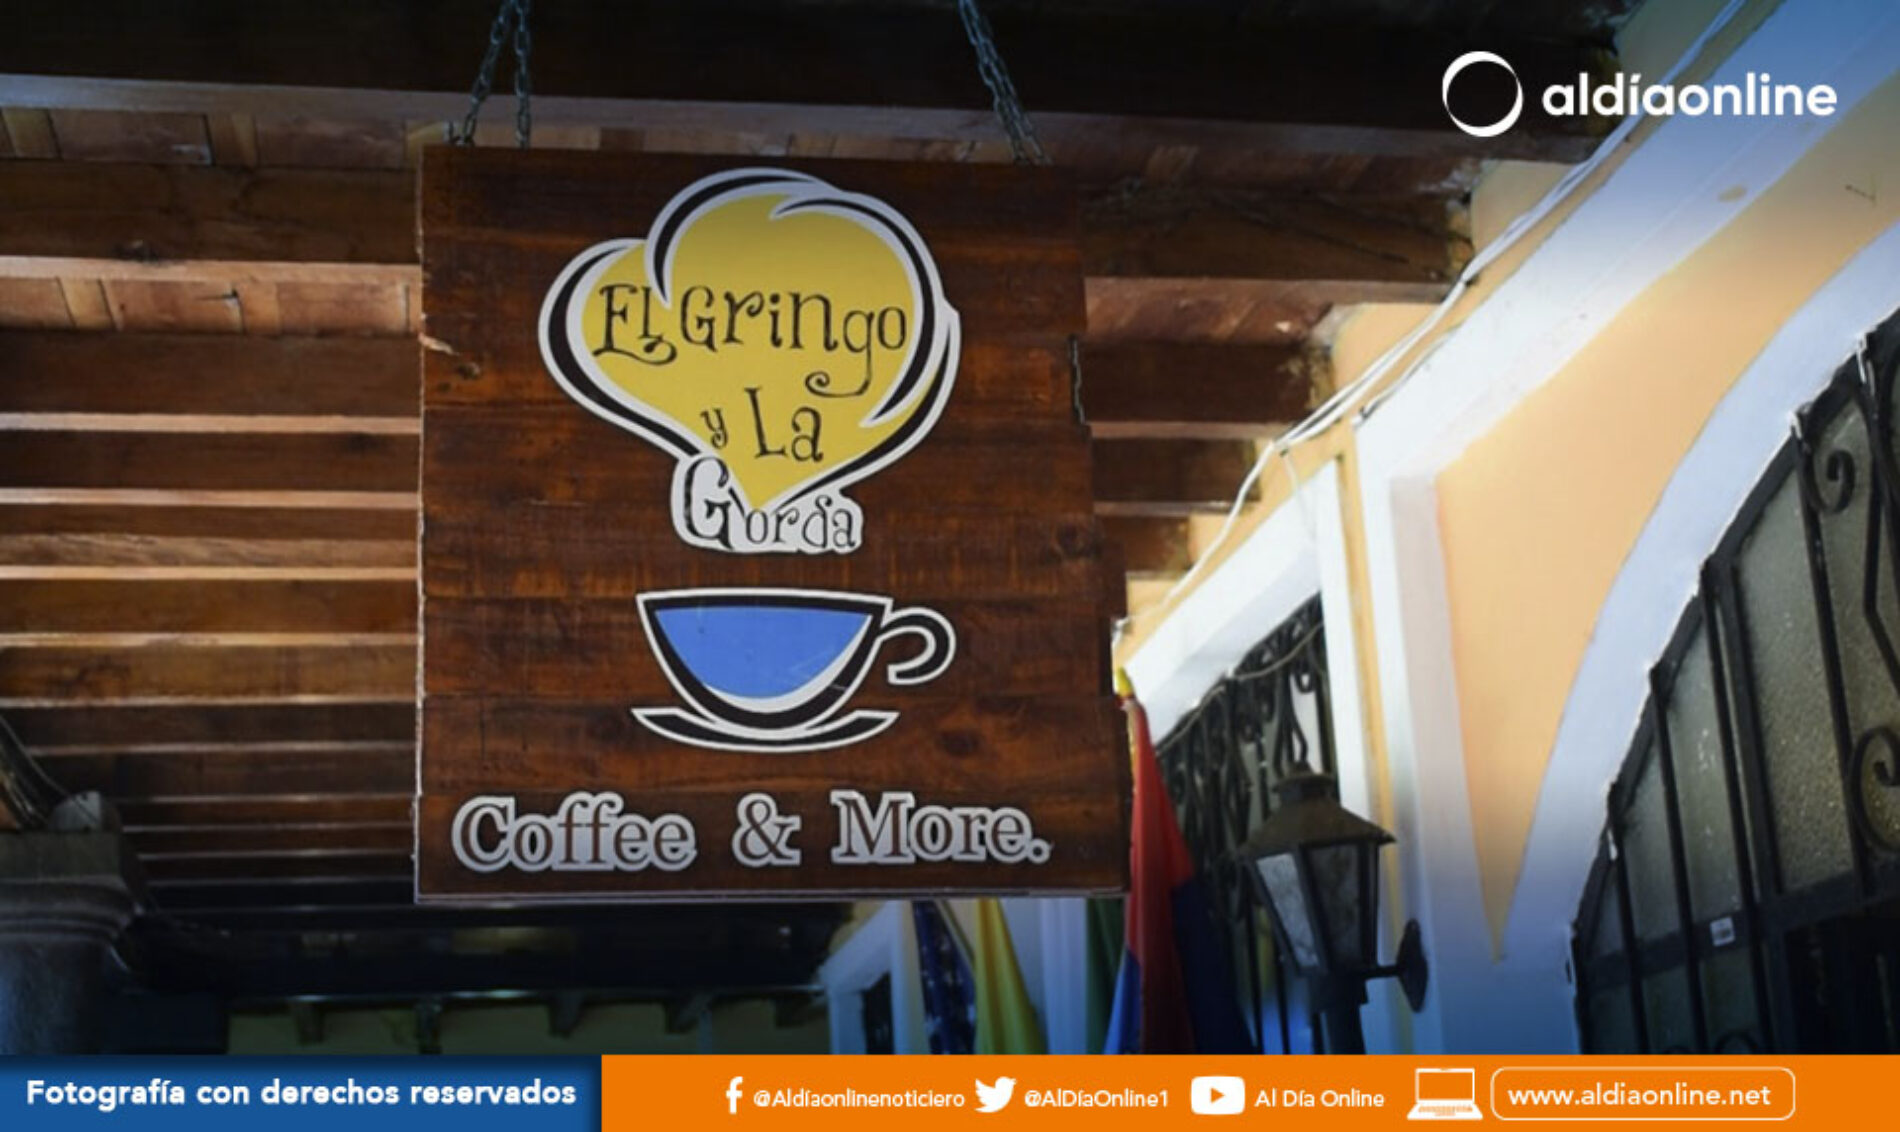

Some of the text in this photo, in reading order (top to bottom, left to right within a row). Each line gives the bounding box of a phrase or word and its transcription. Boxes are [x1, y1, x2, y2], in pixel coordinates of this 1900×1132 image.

[592, 282, 907, 398] El Gringo
[699, 387, 823, 463] y La
[684, 457, 857, 550] Gorda
[452, 789, 1052, 871] Coffee & More.
